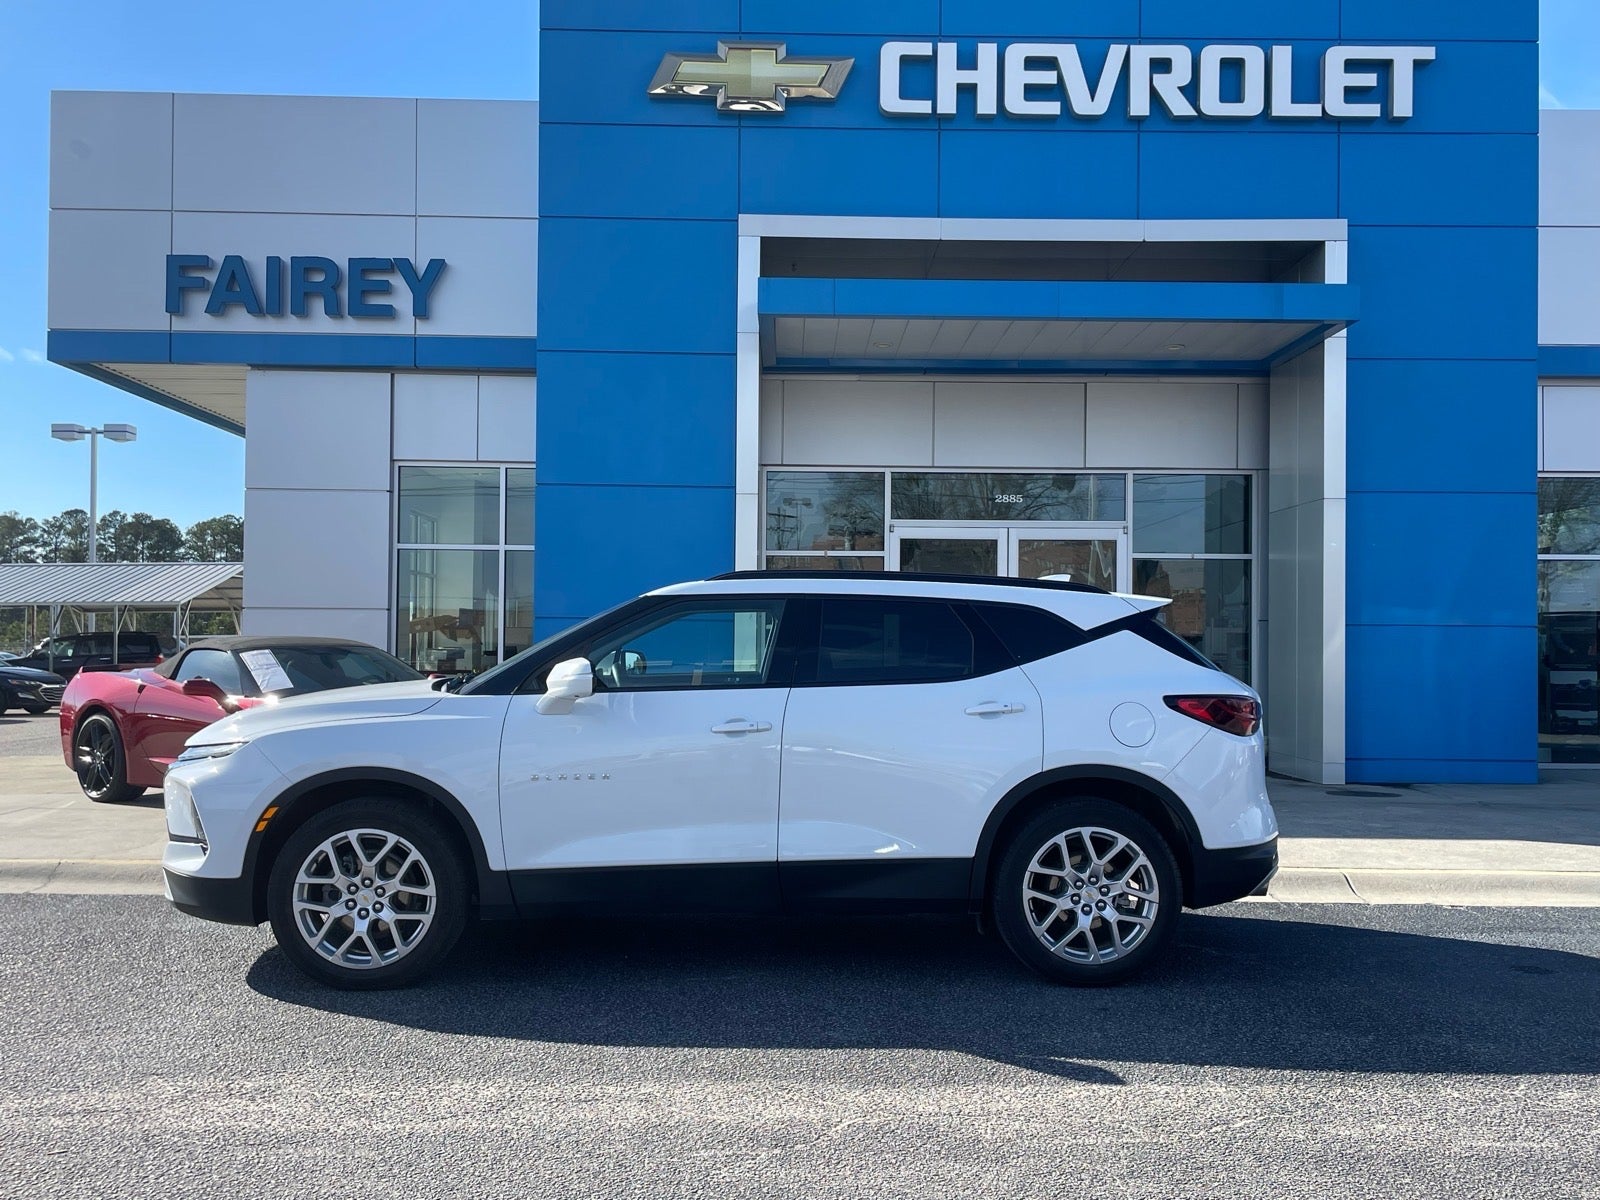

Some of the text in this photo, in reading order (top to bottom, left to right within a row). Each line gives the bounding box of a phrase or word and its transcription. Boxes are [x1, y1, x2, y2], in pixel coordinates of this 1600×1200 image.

[879, 41, 1437, 119] CHEVROLET
[165, 254, 447, 318] FAIREY
[994, 494, 1024, 503] 2885
[529, 773, 611, 781] BLAZER
